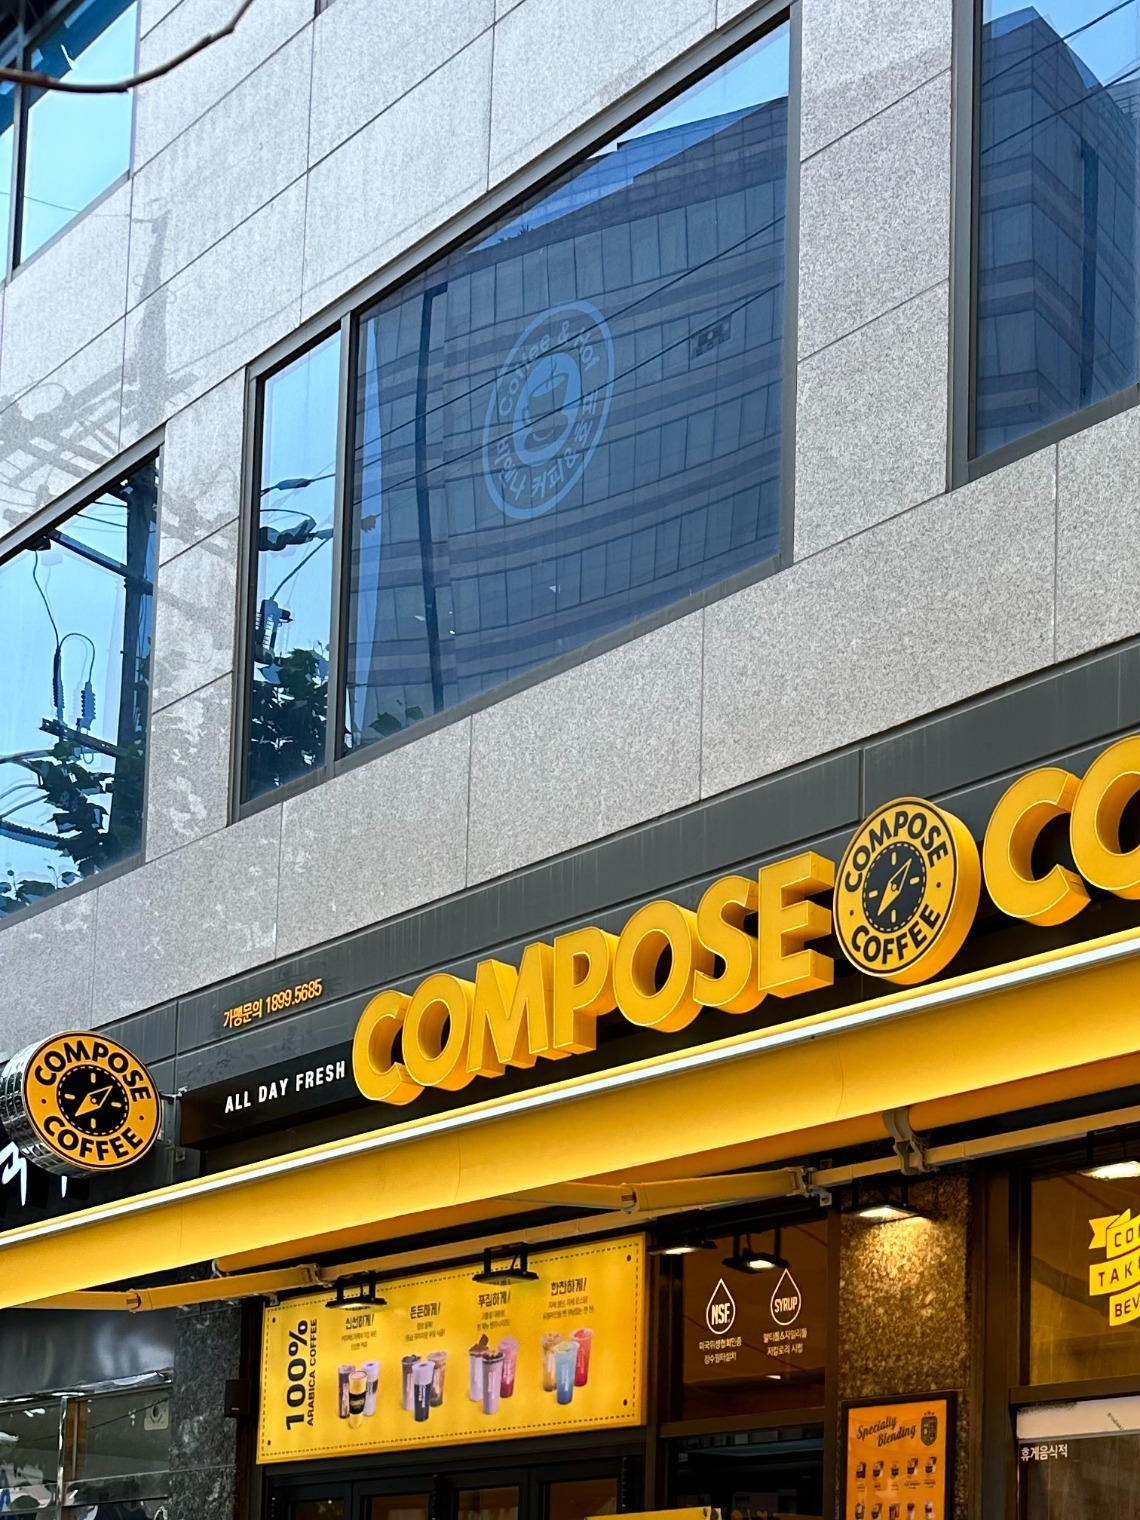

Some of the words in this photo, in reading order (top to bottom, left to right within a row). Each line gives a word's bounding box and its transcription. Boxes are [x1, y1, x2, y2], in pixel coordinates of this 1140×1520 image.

[500, 333, 551, 417] Coffee
[845, 811, 949, 892] COMPOSE
[851, 903, 942, 965] COFFEE
[223, 998, 263, 1029] 가맹문의
[266, 978, 322, 1013] 1899.5685
[353, 852, 834, 1105] COMPOSE
[34, 1040, 152, 1103] COMPOSE
[225, 1091, 251, 1113] ALL
[258, 1078, 288, 1104] DAY
[296, 1061, 346, 1092] FRESH
[43, 1115, 144, 1162] COFFEE
[410, 1302, 440, 1320] 든든하게!
[478, 1290, 511, 1308] 푸짐하게!
[711, 1303, 730, 1325] NSF
[774, 1297, 797, 1313] SYRUP
[309, 1319, 317, 1368] COFFEE
[285, 1319, 309, 1431] 100%
[306, 1370, 317, 1427] ARABICA
[877, 1424, 917, 1447] Blending
